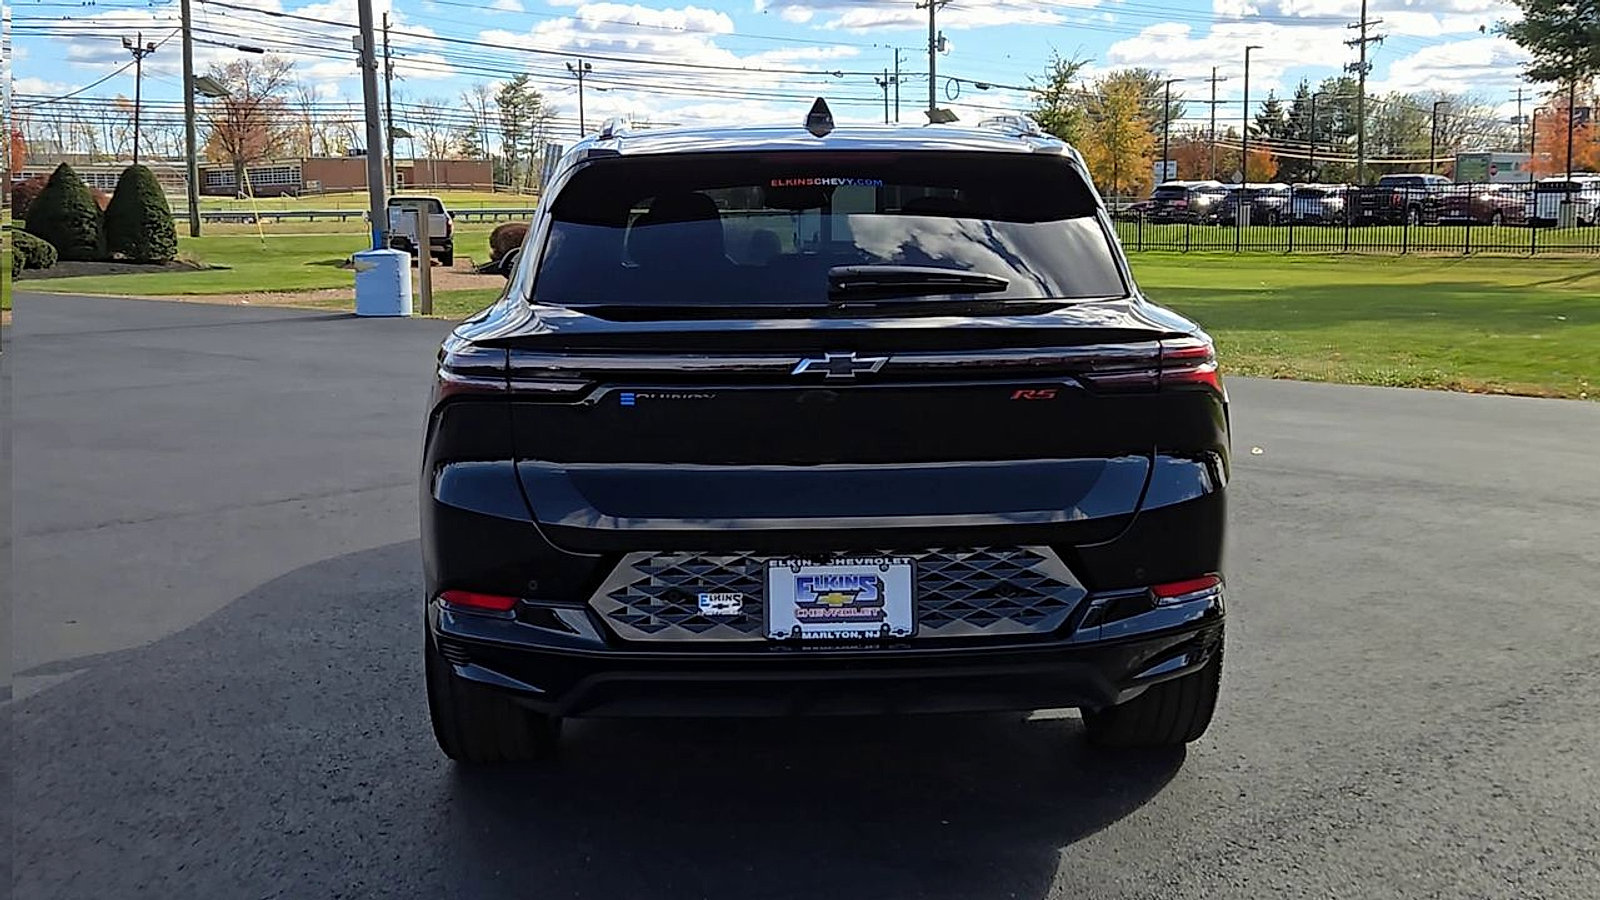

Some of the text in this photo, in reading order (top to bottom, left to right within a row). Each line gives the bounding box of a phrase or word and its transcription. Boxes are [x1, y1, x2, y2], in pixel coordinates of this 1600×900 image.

[771, 177, 883, 187] ELKINSCHEVY.COM
[1010, 389, 1058, 400] RS
[795, 574, 879, 601] ELKINS
[700, 594, 742, 607] ELKINS
[796, 607, 881, 618] CHEVROLET
[802, 631, 862, 640] MARLTON,
